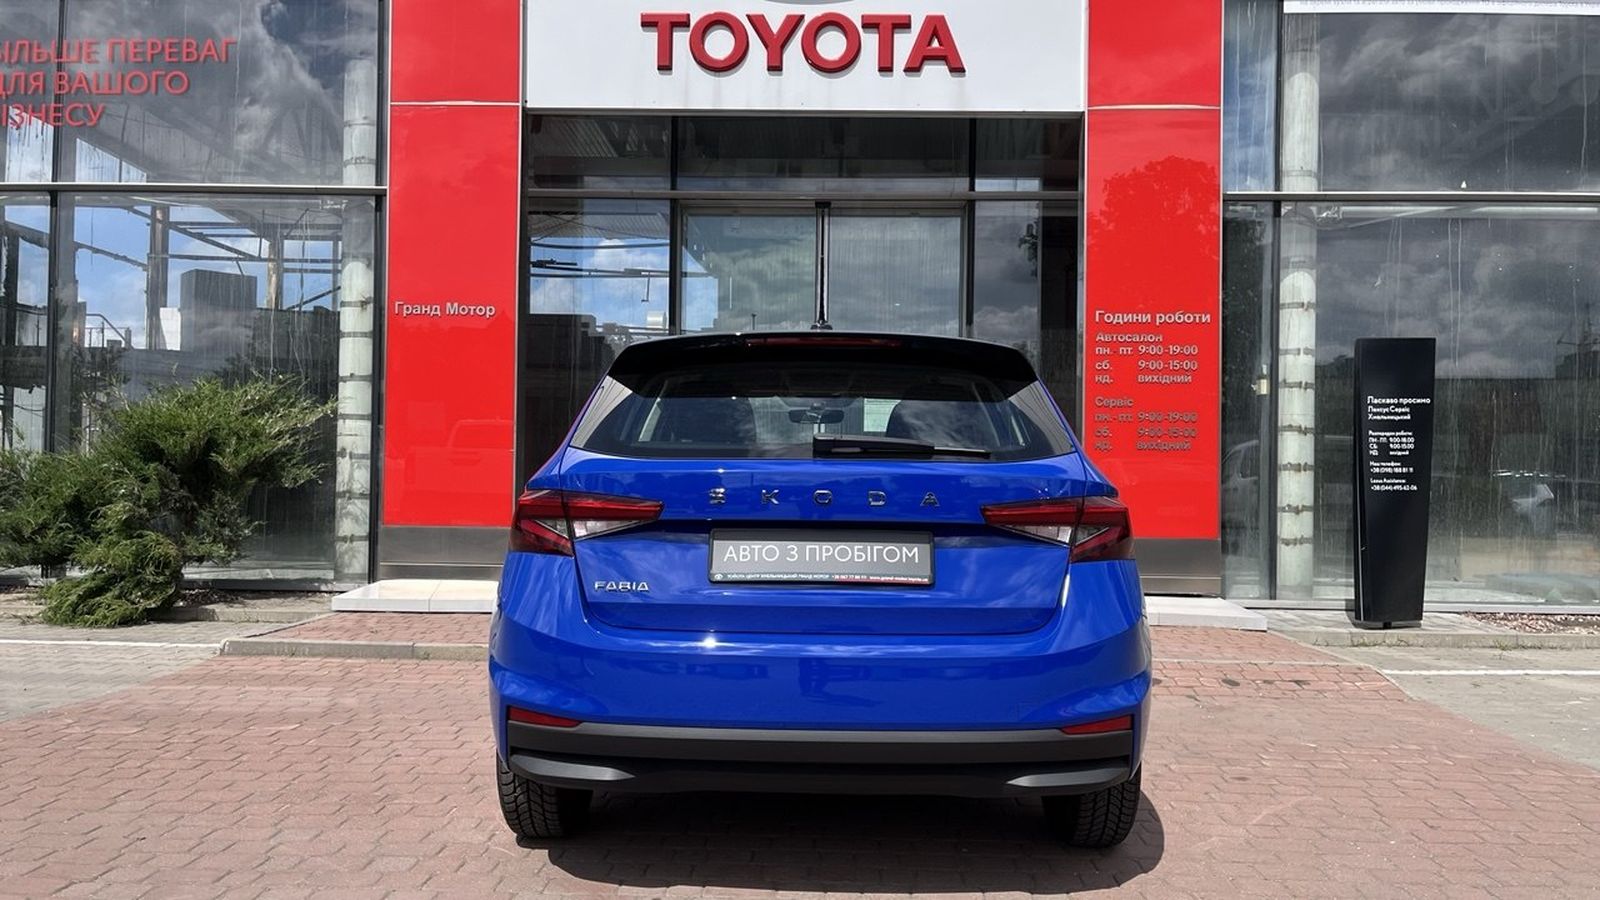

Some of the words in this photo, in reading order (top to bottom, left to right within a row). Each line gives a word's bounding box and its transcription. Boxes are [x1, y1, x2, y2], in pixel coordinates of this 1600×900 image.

[641, 11, 966, 73] TOYOTA
[0, 39, 100, 64] ІЛЬШЕ
[106, 37, 238, 63] ПЕРЕВАГ
[54, 69, 191, 96] ВАШОГО
[394, 301, 441, 317] Гранд
[445, 301, 496, 318] Мотор
[1094, 310, 1151, 325] Години
[1155, 310, 1211, 326] роботи
[1095, 332, 1163, 343] Автосалон
[1137, 372, 1192, 385] вихідний
[1094, 396, 1134, 408] Сервіс
[1367, 395, 1398, 404] Ласкаво
[723, 544, 780, 562] АВТО
[786, 544, 799, 562] З
[805, 544, 919, 563] ПРОБІГОМ
[594, 580, 650, 592] FABIA
